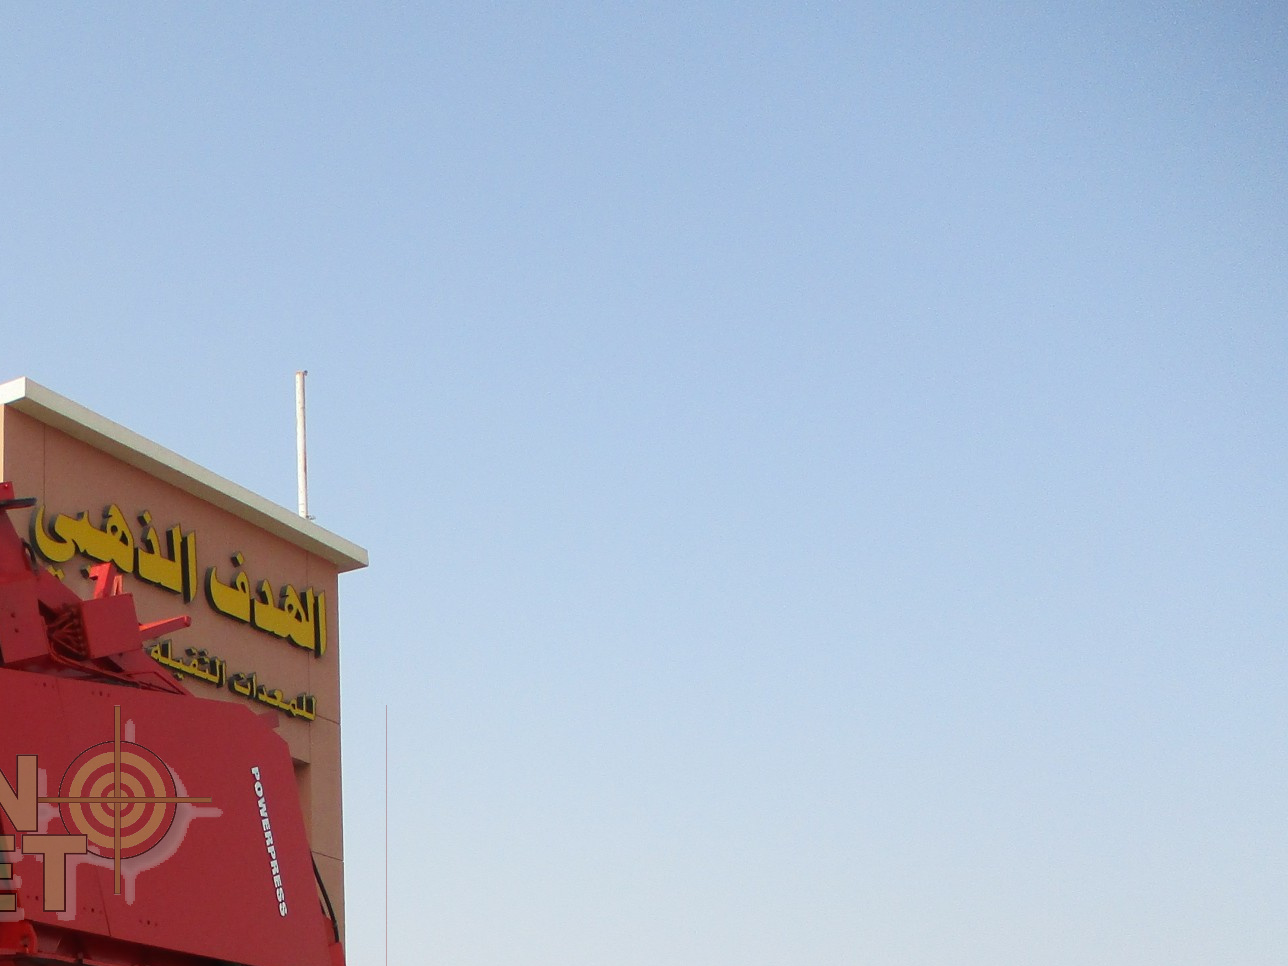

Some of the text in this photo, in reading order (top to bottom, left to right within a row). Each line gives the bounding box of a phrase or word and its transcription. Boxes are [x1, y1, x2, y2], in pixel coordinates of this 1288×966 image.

[206, 551, 327, 657] الهدف
[228, 670, 316, 721] للمعدات
[251, 766, 288, 917] POWERPRESS
